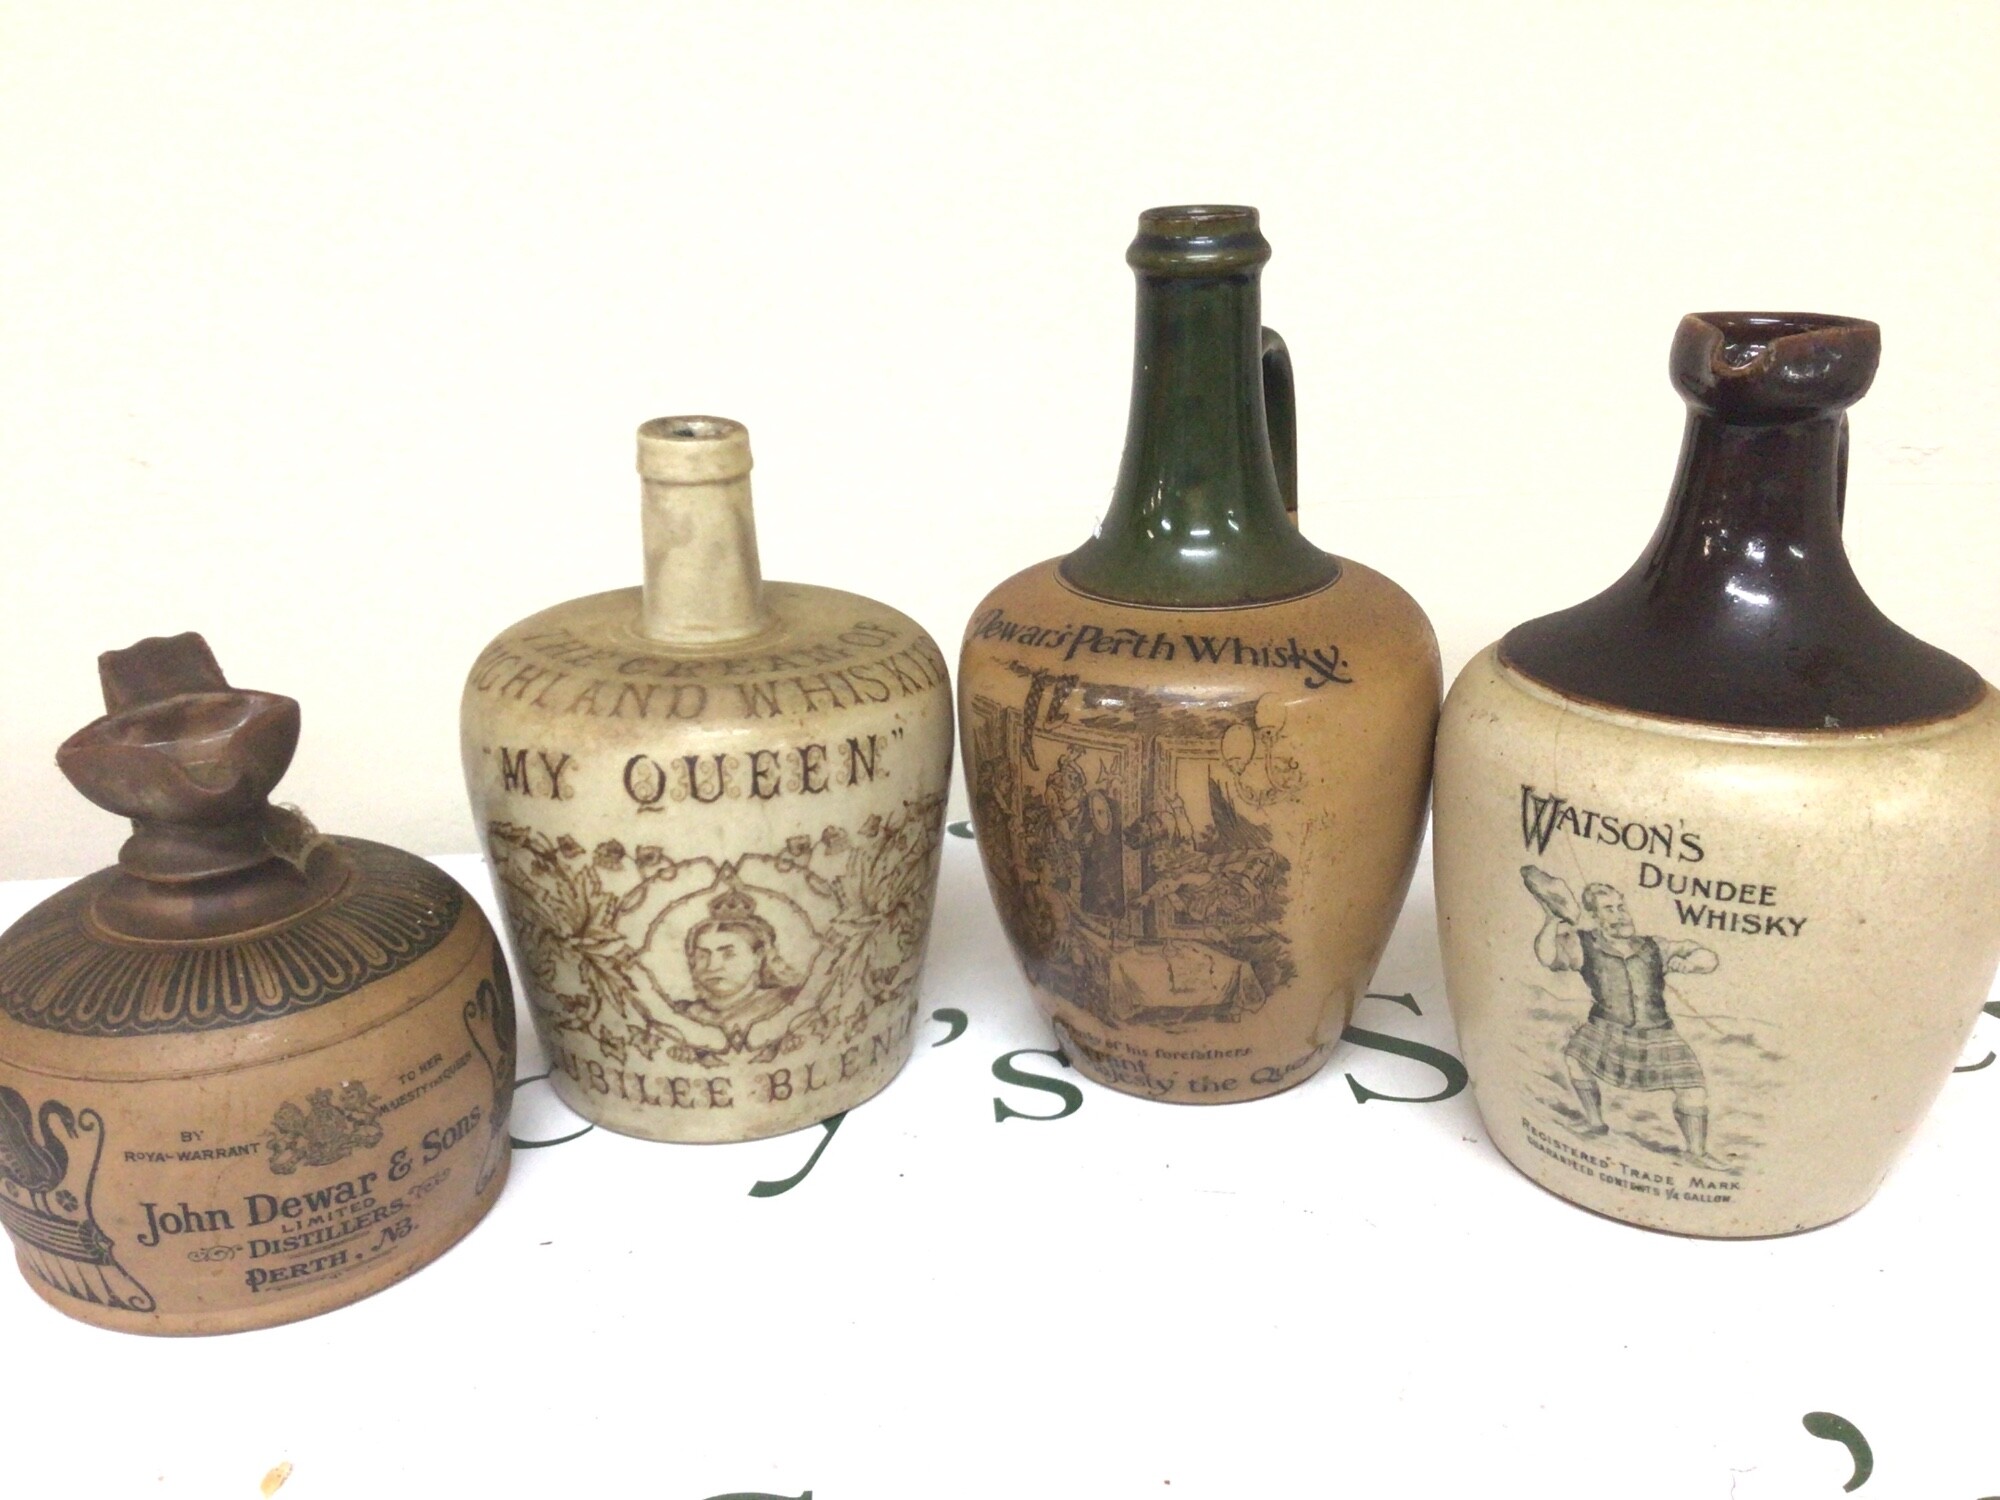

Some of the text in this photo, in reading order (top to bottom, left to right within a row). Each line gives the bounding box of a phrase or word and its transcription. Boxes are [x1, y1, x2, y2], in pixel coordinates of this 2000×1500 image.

[1063, 624, 1175, 661] Perth
[1638, 862, 1777, 907] DUNDEE
[1674, 899, 1807, 938] WHISKY
[399, 1070, 416, 1085] TO
[563, 1046, 734, 1109] UBILEE
[1187, 1075, 1239, 1094] the
[180, 1130, 204, 1143] BY
[1521, 1117, 1741, 1191] REGISTERED TRADE MARK
[137, 1201, 235, 1247] John
[243, 1173, 378, 1227] Dewar
[388, 1147, 413, 1182] &
[422, 1105, 481, 1165] Sons
[281, 1197, 376, 1234] LIMITED
